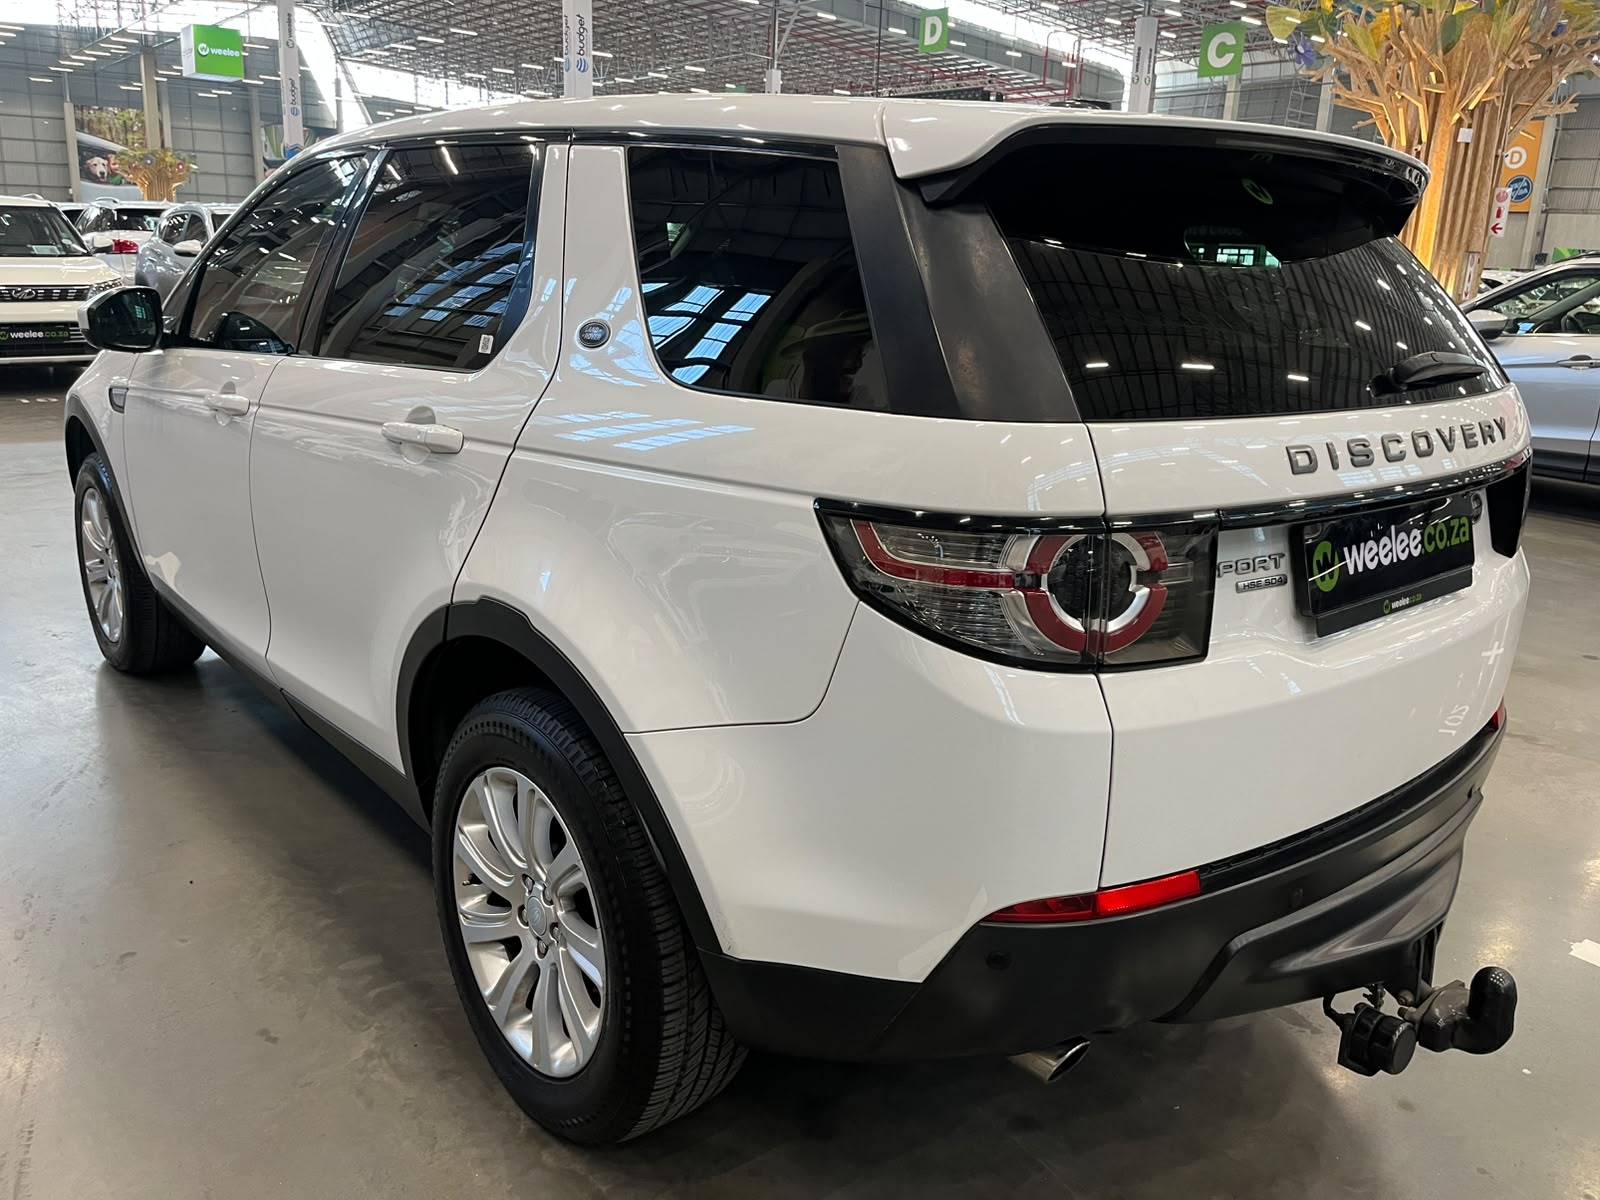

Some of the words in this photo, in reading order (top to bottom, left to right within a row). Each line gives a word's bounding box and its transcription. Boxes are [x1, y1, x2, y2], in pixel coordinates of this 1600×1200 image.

[576, 13, 588, 56] budget
[924, 16, 942, 46] D
[210, 48, 240, 57] weelee
[1207, 32, 1236, 68] C
[289, 78, 298, 105] budget
[1509, 151, 1522, 164] D
[1285, 416, 1506, 475] DISCOVERY
[1343, 516, 1470, 575] weelee.co.za
[1217, 552, 1286, 578] PORT
[1243, 580, 1262, 590] HSE
